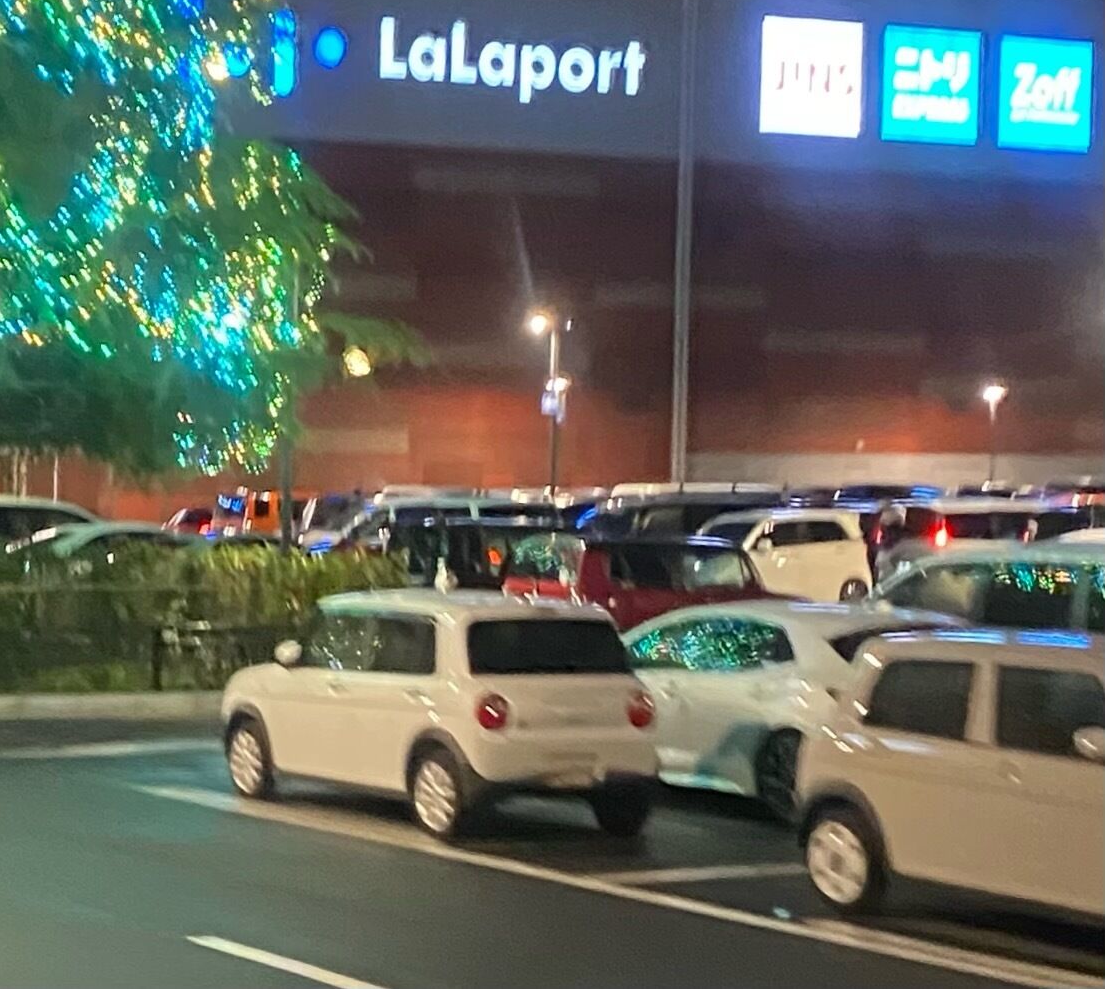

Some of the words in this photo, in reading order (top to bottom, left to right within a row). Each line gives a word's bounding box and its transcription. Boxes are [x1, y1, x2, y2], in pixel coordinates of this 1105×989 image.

[379, 16, 646, 104] LaLaport
[893, 46, 971, 94] ニトリ
[1010, 62, 1081, 111] Zoff
